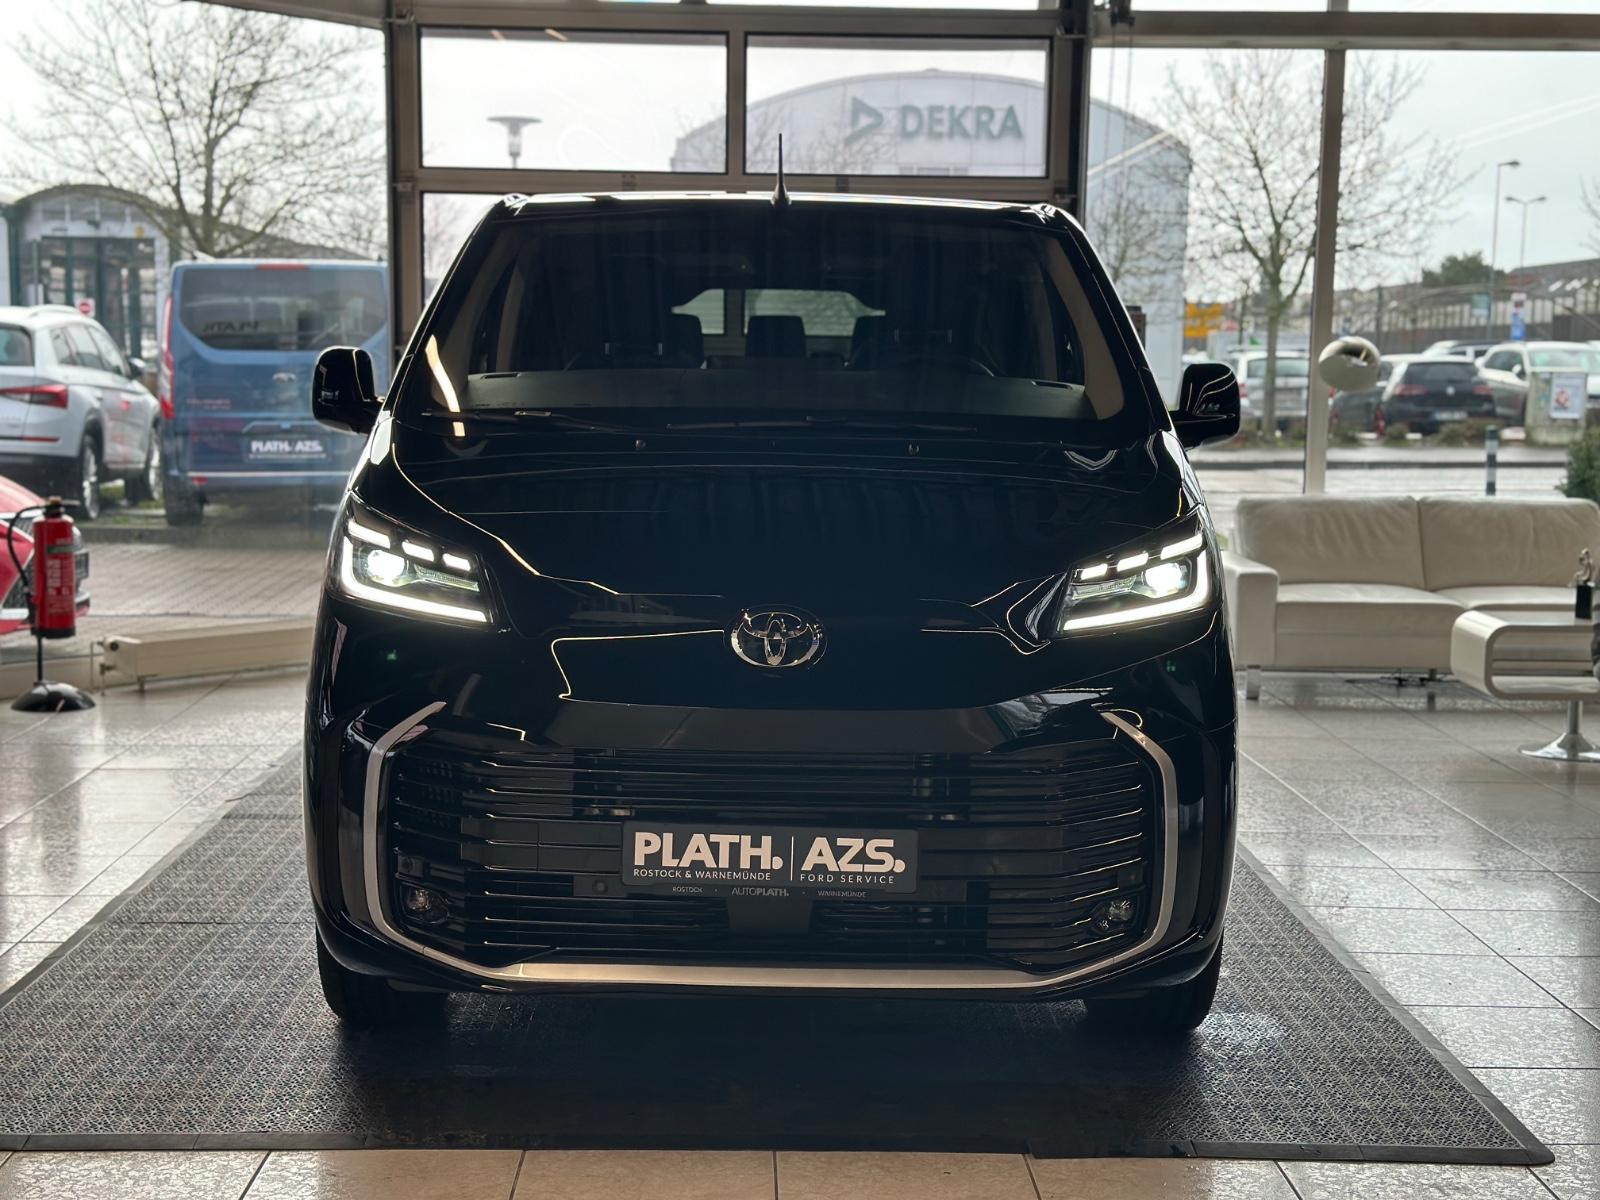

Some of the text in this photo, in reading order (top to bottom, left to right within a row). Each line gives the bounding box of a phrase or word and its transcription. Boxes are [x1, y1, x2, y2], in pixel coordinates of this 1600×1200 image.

[901, 105, 1024, 140] DEKRA
[634, 831, 906, 873] PLATH. AZS.
[633, 868, 771, 881] ROSTOCK & WARNEMÜNDE
[800, 874, 894, 884] FORD SERVICE
